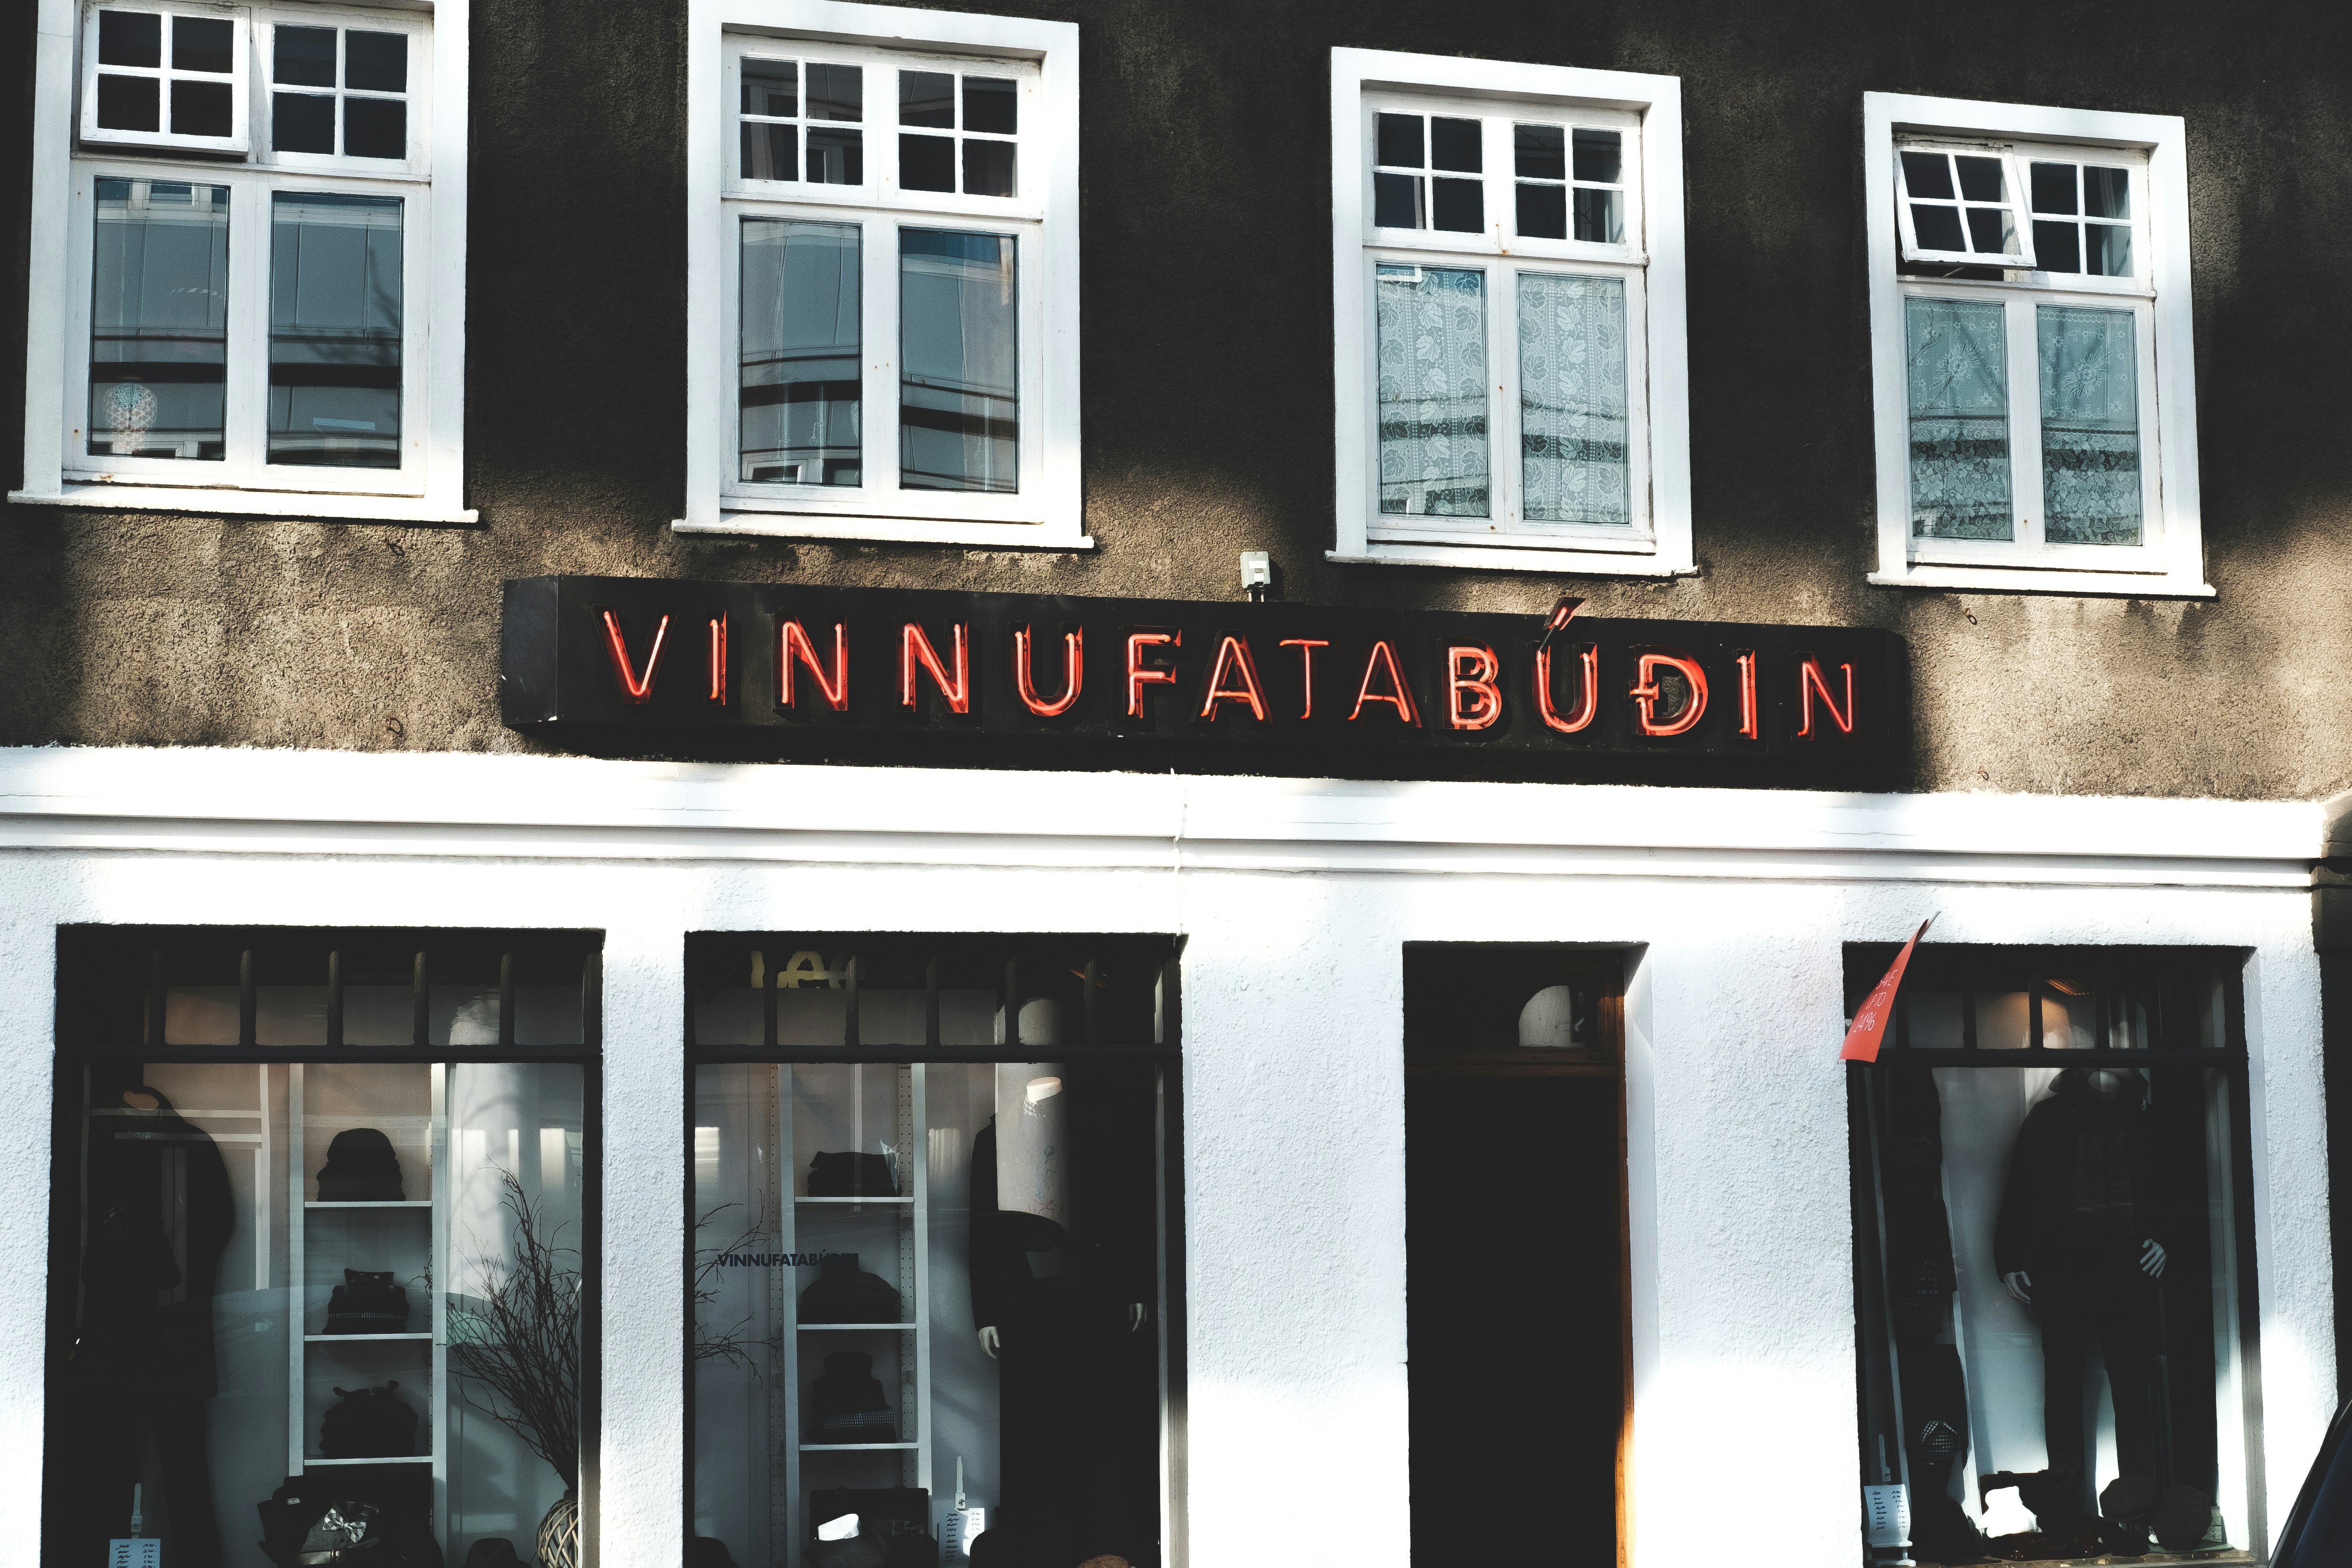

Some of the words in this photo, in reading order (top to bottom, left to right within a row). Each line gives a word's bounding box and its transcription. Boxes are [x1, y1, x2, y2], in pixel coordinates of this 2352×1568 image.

[592, 596, 1861, 742] VINNUFATABÚÐIN
[1853, 1011, 1877, 1033] 14%
[717, 1248, 859, 1267] VINNUFATABÚ
